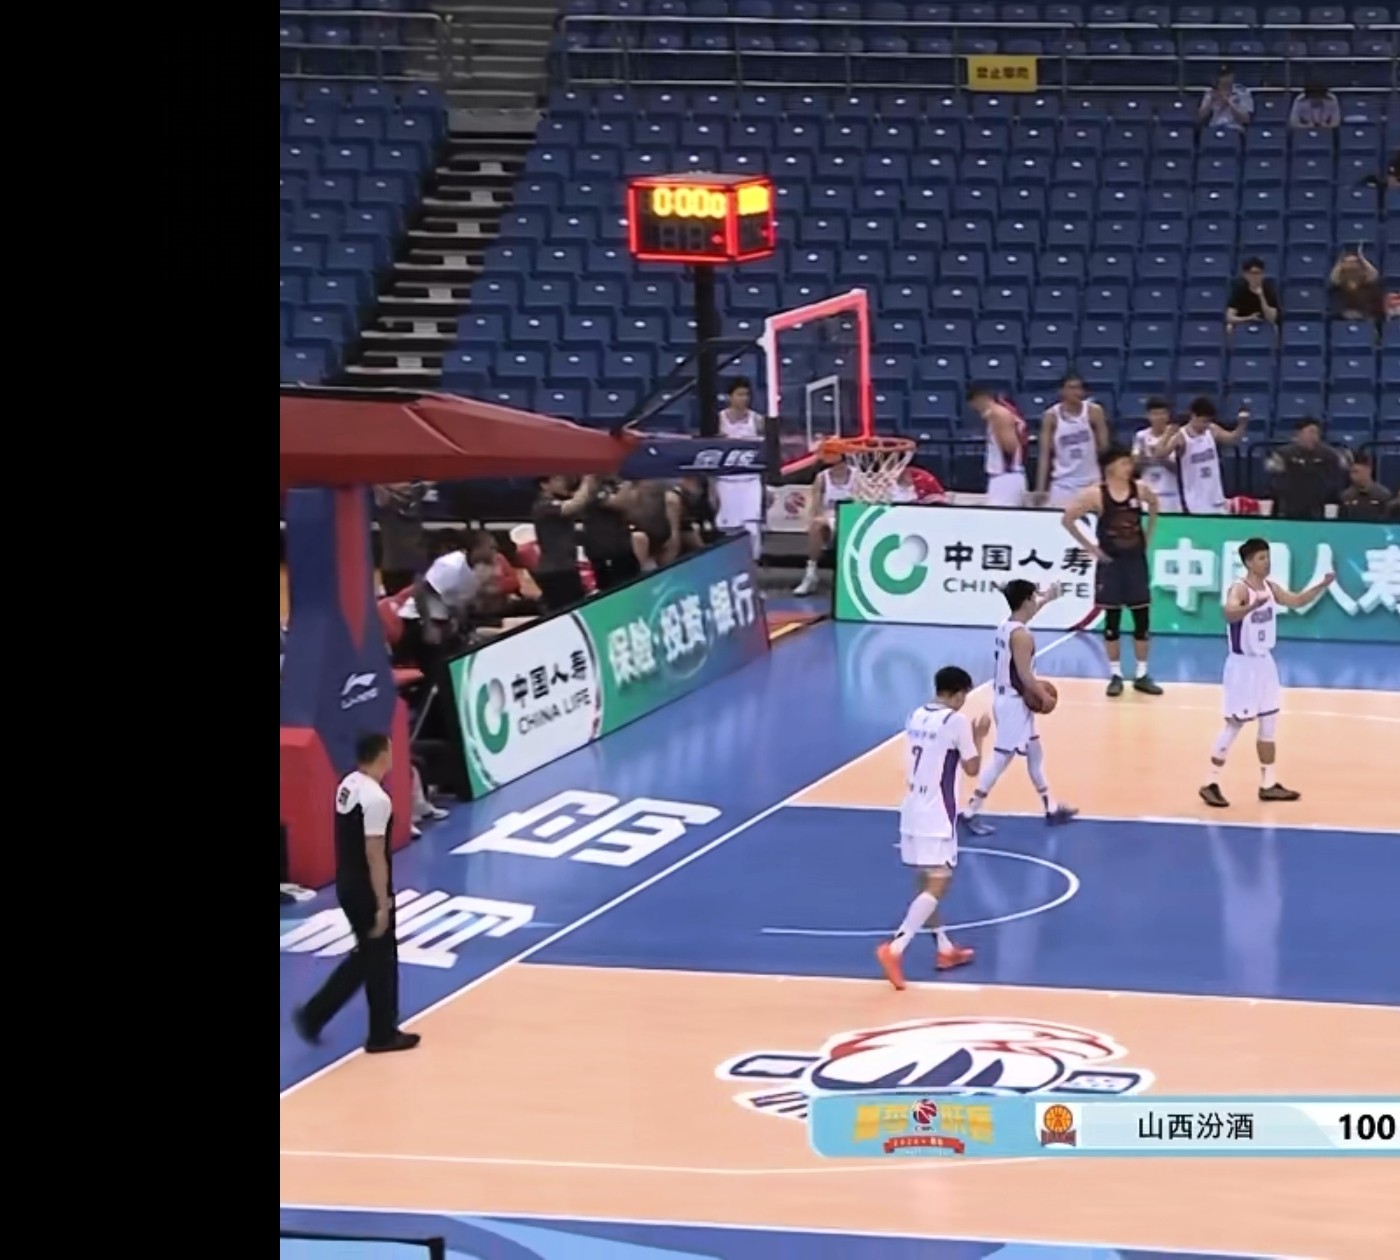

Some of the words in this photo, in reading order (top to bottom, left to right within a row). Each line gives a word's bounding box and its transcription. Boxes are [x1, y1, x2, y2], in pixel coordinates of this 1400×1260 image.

[944, 541, 1092, 576] 中国人寿
[943, 577, 1006, 593] CHIN
[511, 650, 587, 709] 中国人寿
[518, 704, 561, 735] CHINA
[563, 688, 591, 714] LIFE
[911, 745, 923, 776] 7
